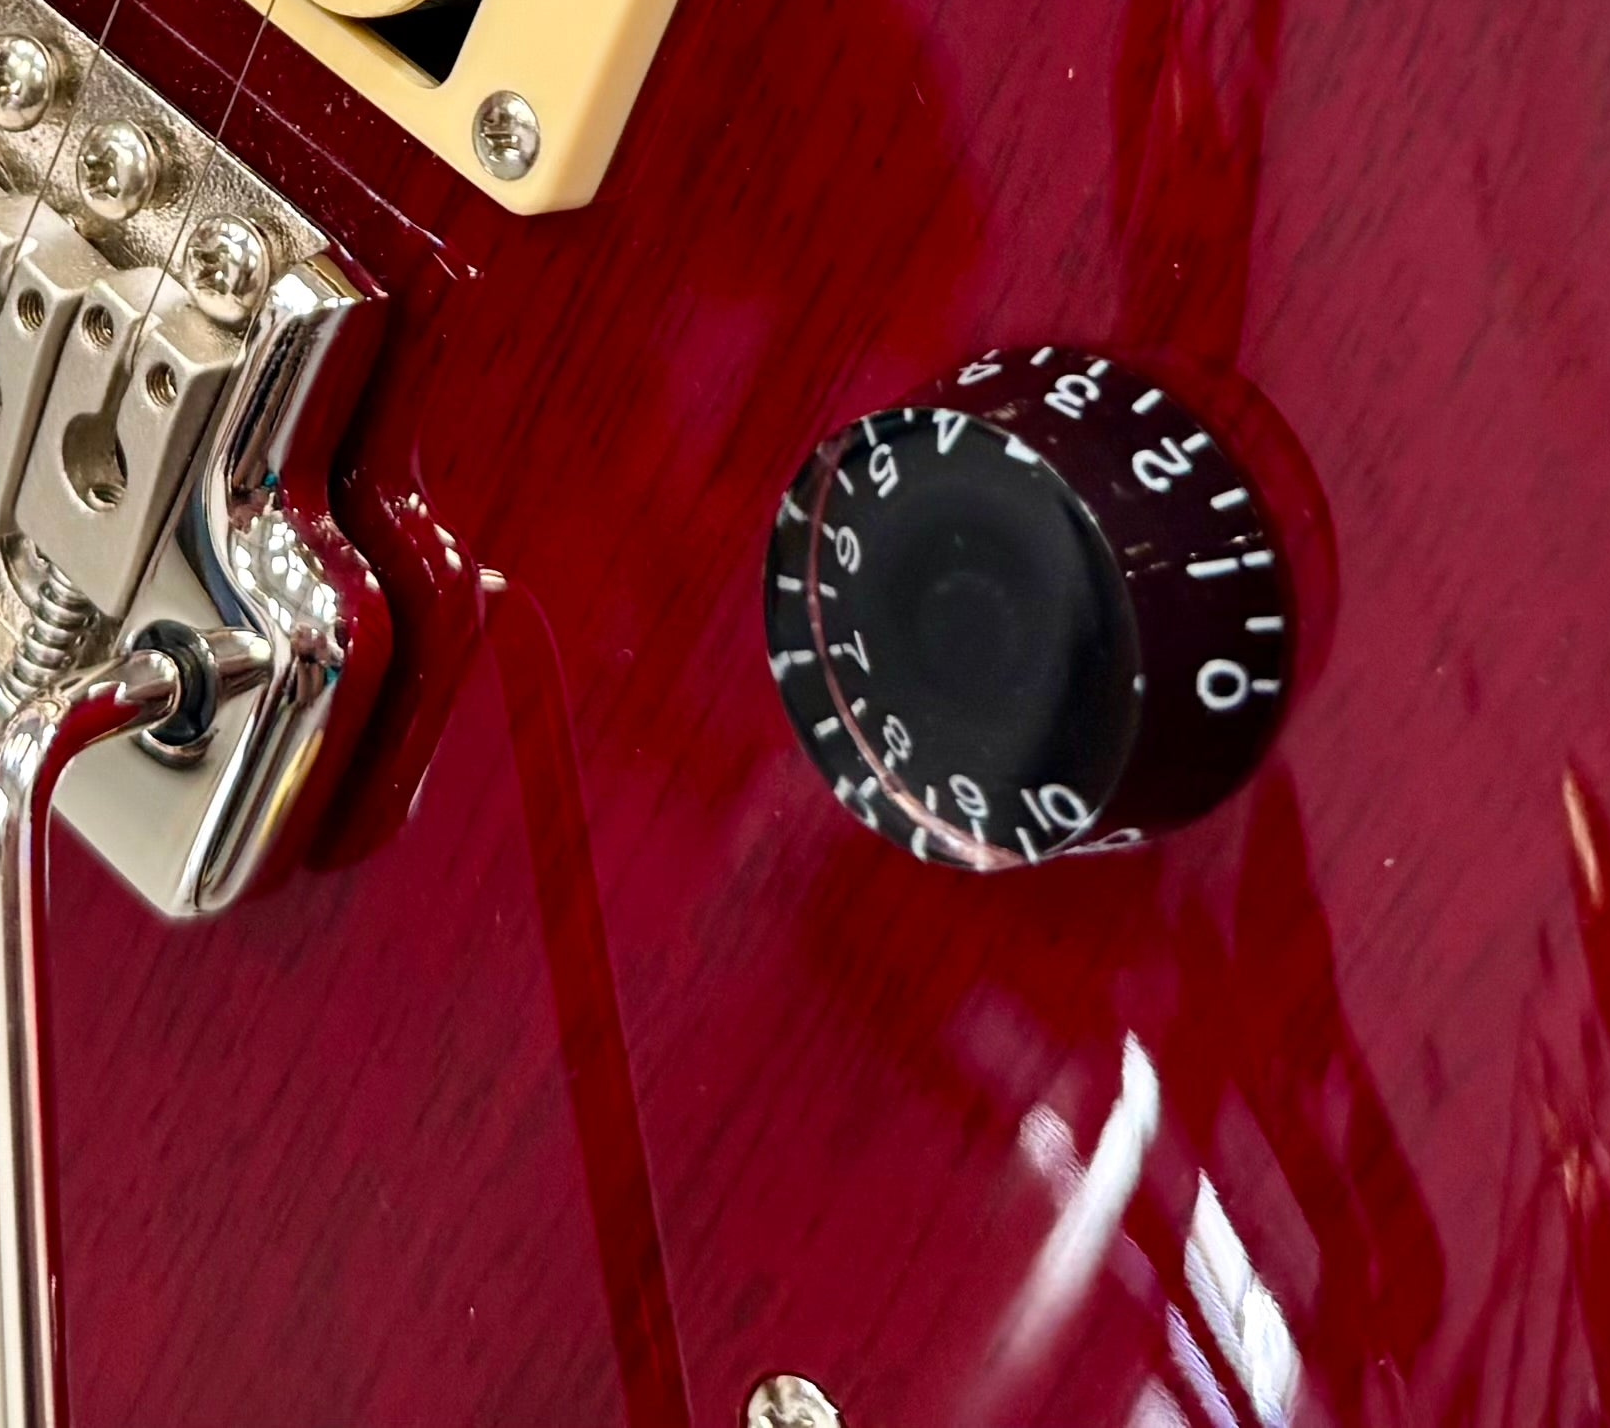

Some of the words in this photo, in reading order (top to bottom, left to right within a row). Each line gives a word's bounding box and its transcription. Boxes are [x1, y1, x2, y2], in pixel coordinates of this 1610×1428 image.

[1044, 373, 1100, 419] 3
[869, 443, 899, 498] 5
[1132, 437, 1191, 493] 2
[836, 525, 871, 574] 6
[842, 630, 870, 675] 7
[1196, 658, 1248, 711] 0
[882, 714, 912, 761] 8
[1020, 783, 1091, 834] 10
